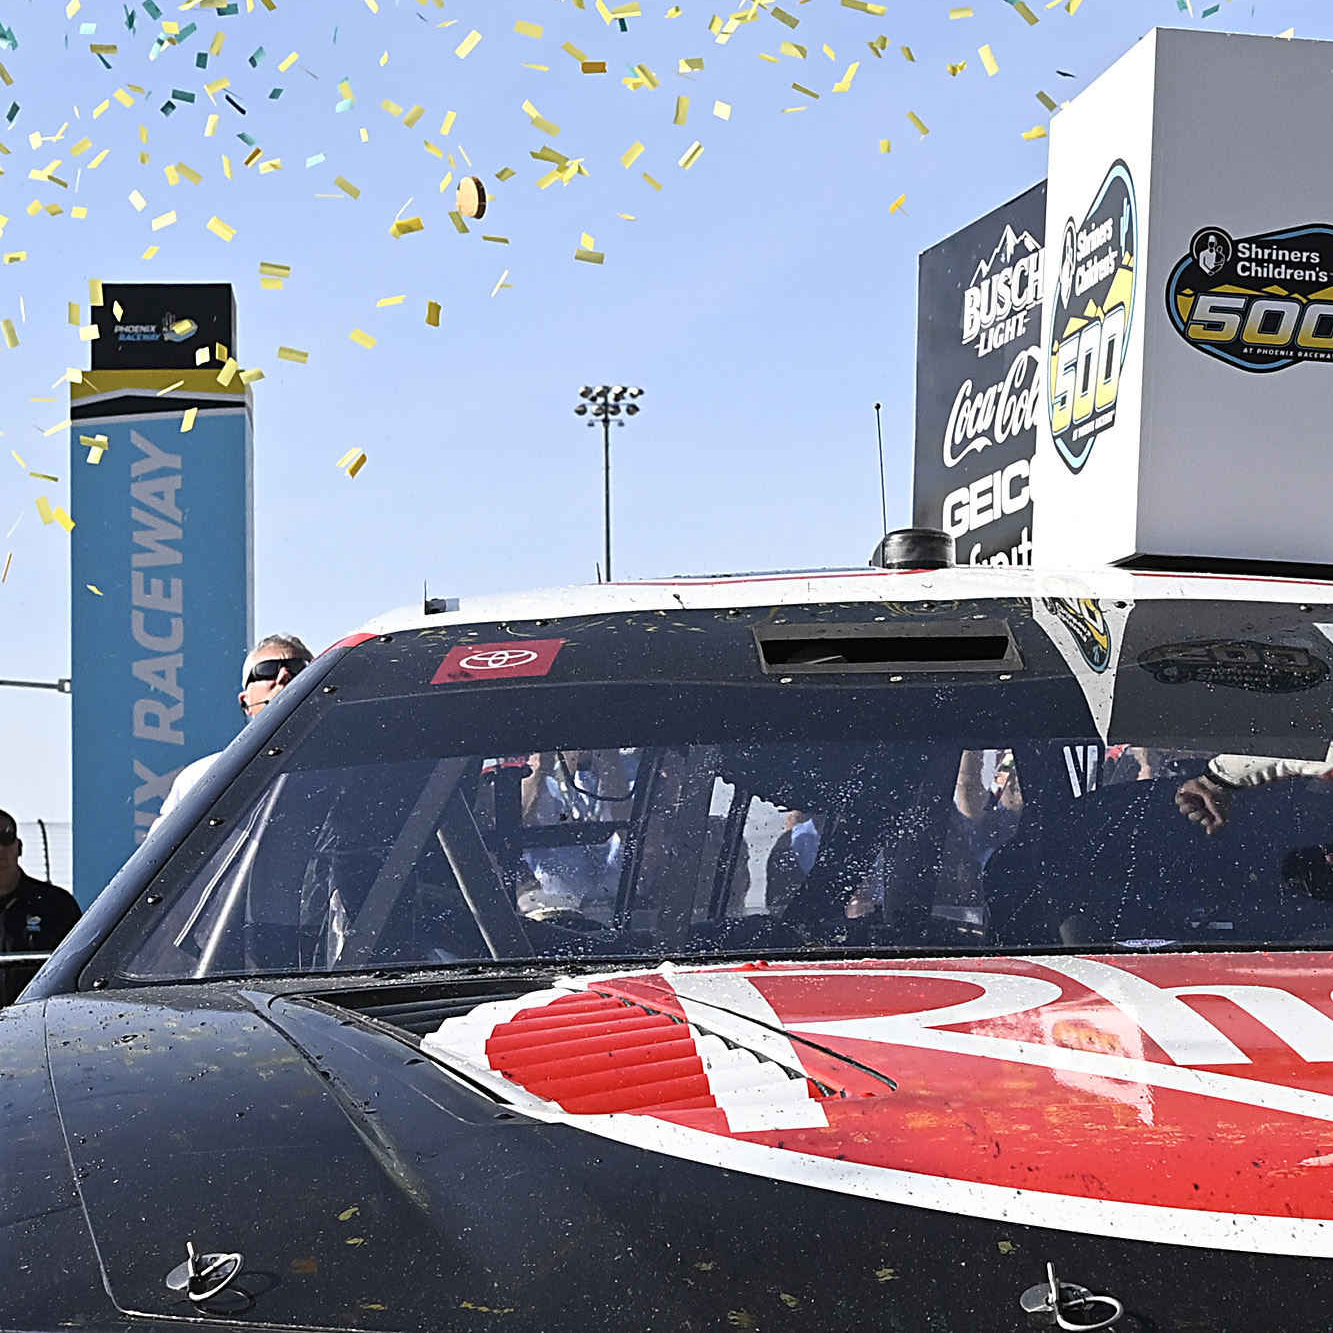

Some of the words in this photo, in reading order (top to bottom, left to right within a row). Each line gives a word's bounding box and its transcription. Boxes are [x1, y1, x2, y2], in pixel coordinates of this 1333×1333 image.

[1077, 217, 1113, 262] Shriners
[1237, 243, 1320, 263] Shriners
[1075, 246, 1115, 297] Children's
[1236, 261, 1329, 282] Children's
[962, 248, 1045, 345] BUSCH
[114, 325, 157, 334] PHOENIX
[119, 333, 161, 341] RACEWAY
[976, 310, 1028, 358] LIGHT
[1256, 348, 1294, 357] PHOENIX
[1052, 305, 1126, 436] 500
[943, 345, 1041, 468] Coca-Col
[943, 454, 1036, 539] GEIC
[130, 430, 185, 746] RACEWAY
